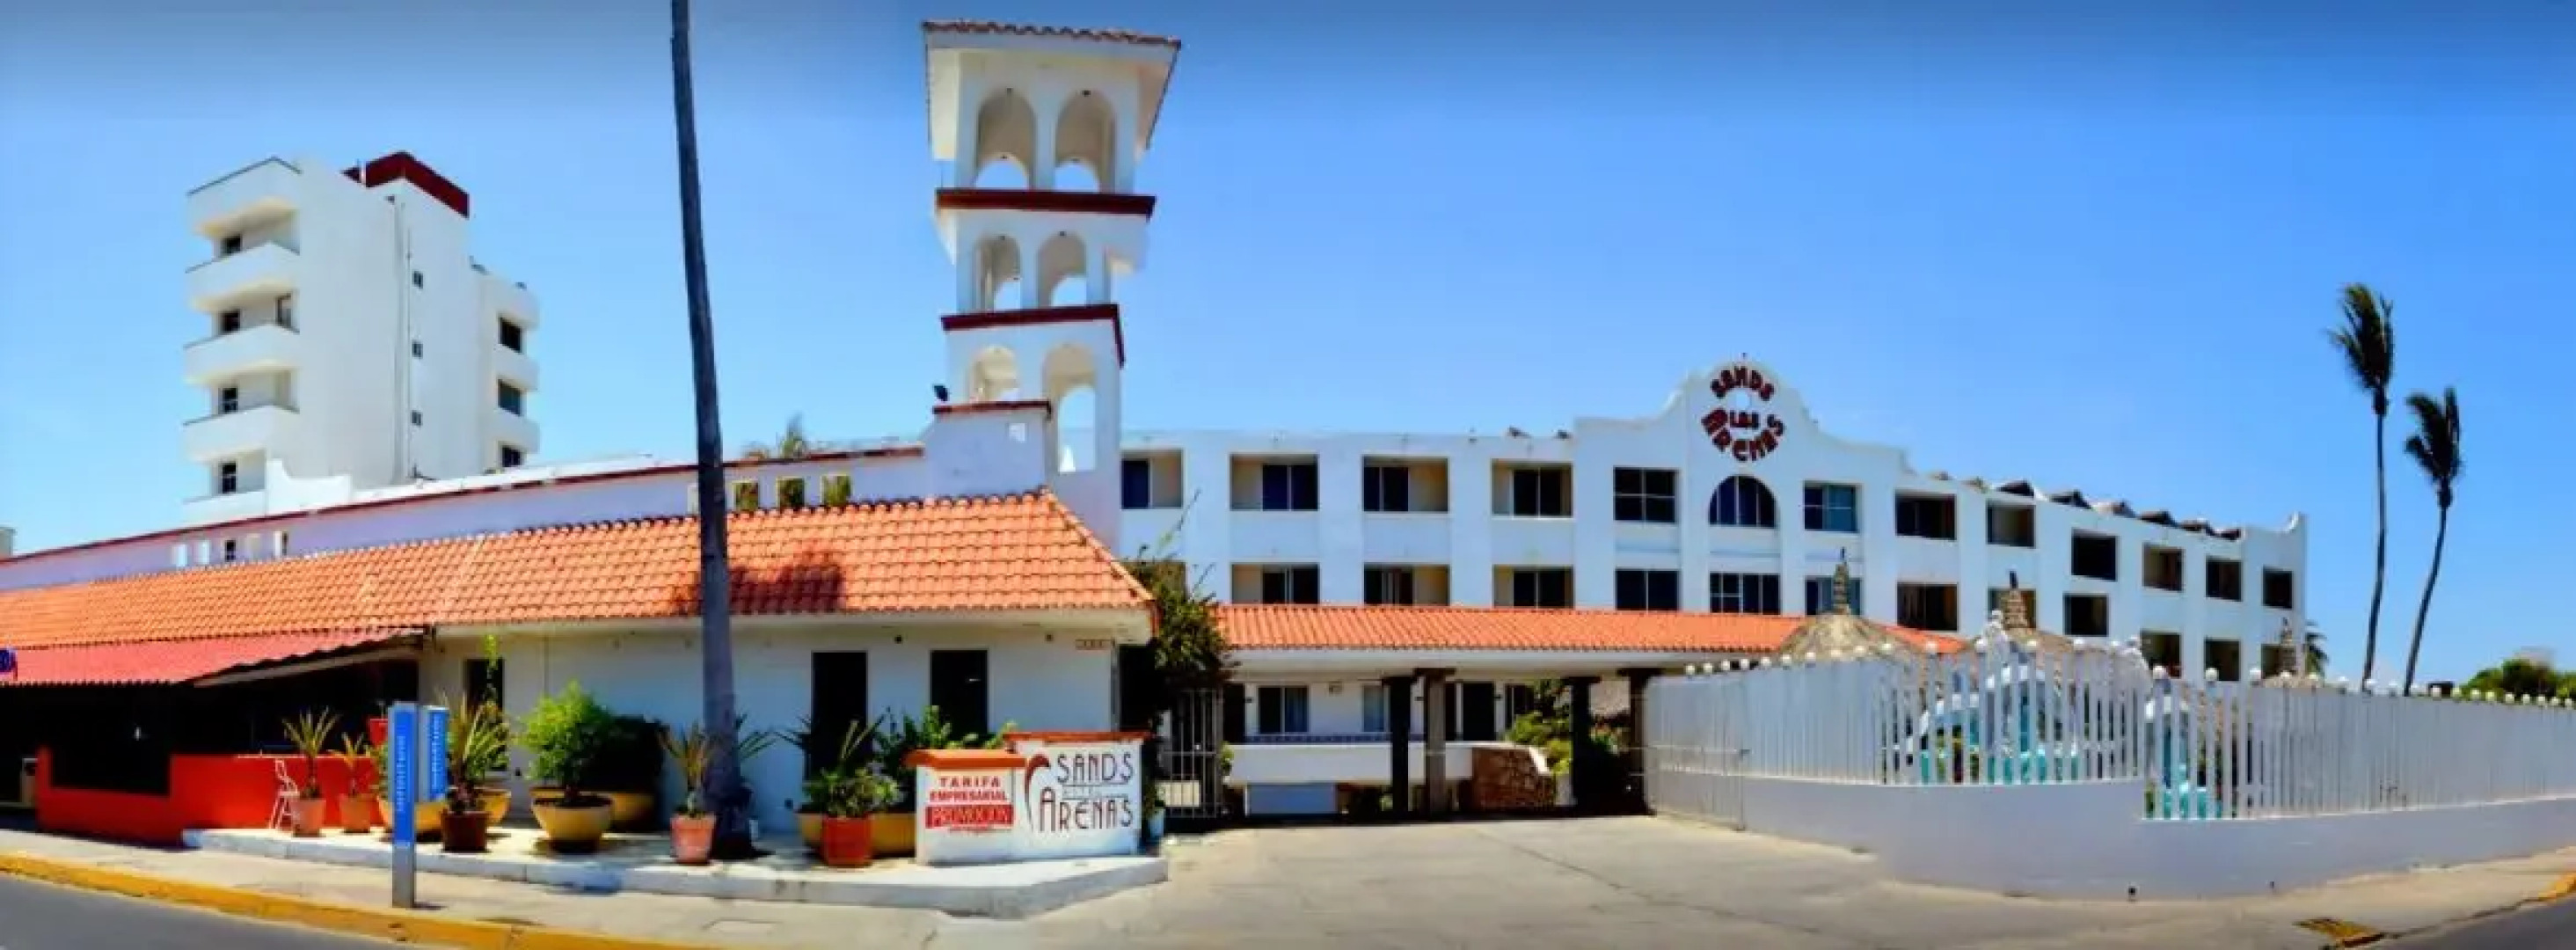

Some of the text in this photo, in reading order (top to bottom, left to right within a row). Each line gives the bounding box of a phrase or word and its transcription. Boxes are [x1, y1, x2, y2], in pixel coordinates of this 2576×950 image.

[1711, 366, 1774, 401] SANDS
[1701, 408, 1784, 463] ARENAS
[938, 776, 1000, 787] TARIFA
[1057, 752, 1134, 783] SANDS
[1040, 786, 1133, 833] ARENAS
